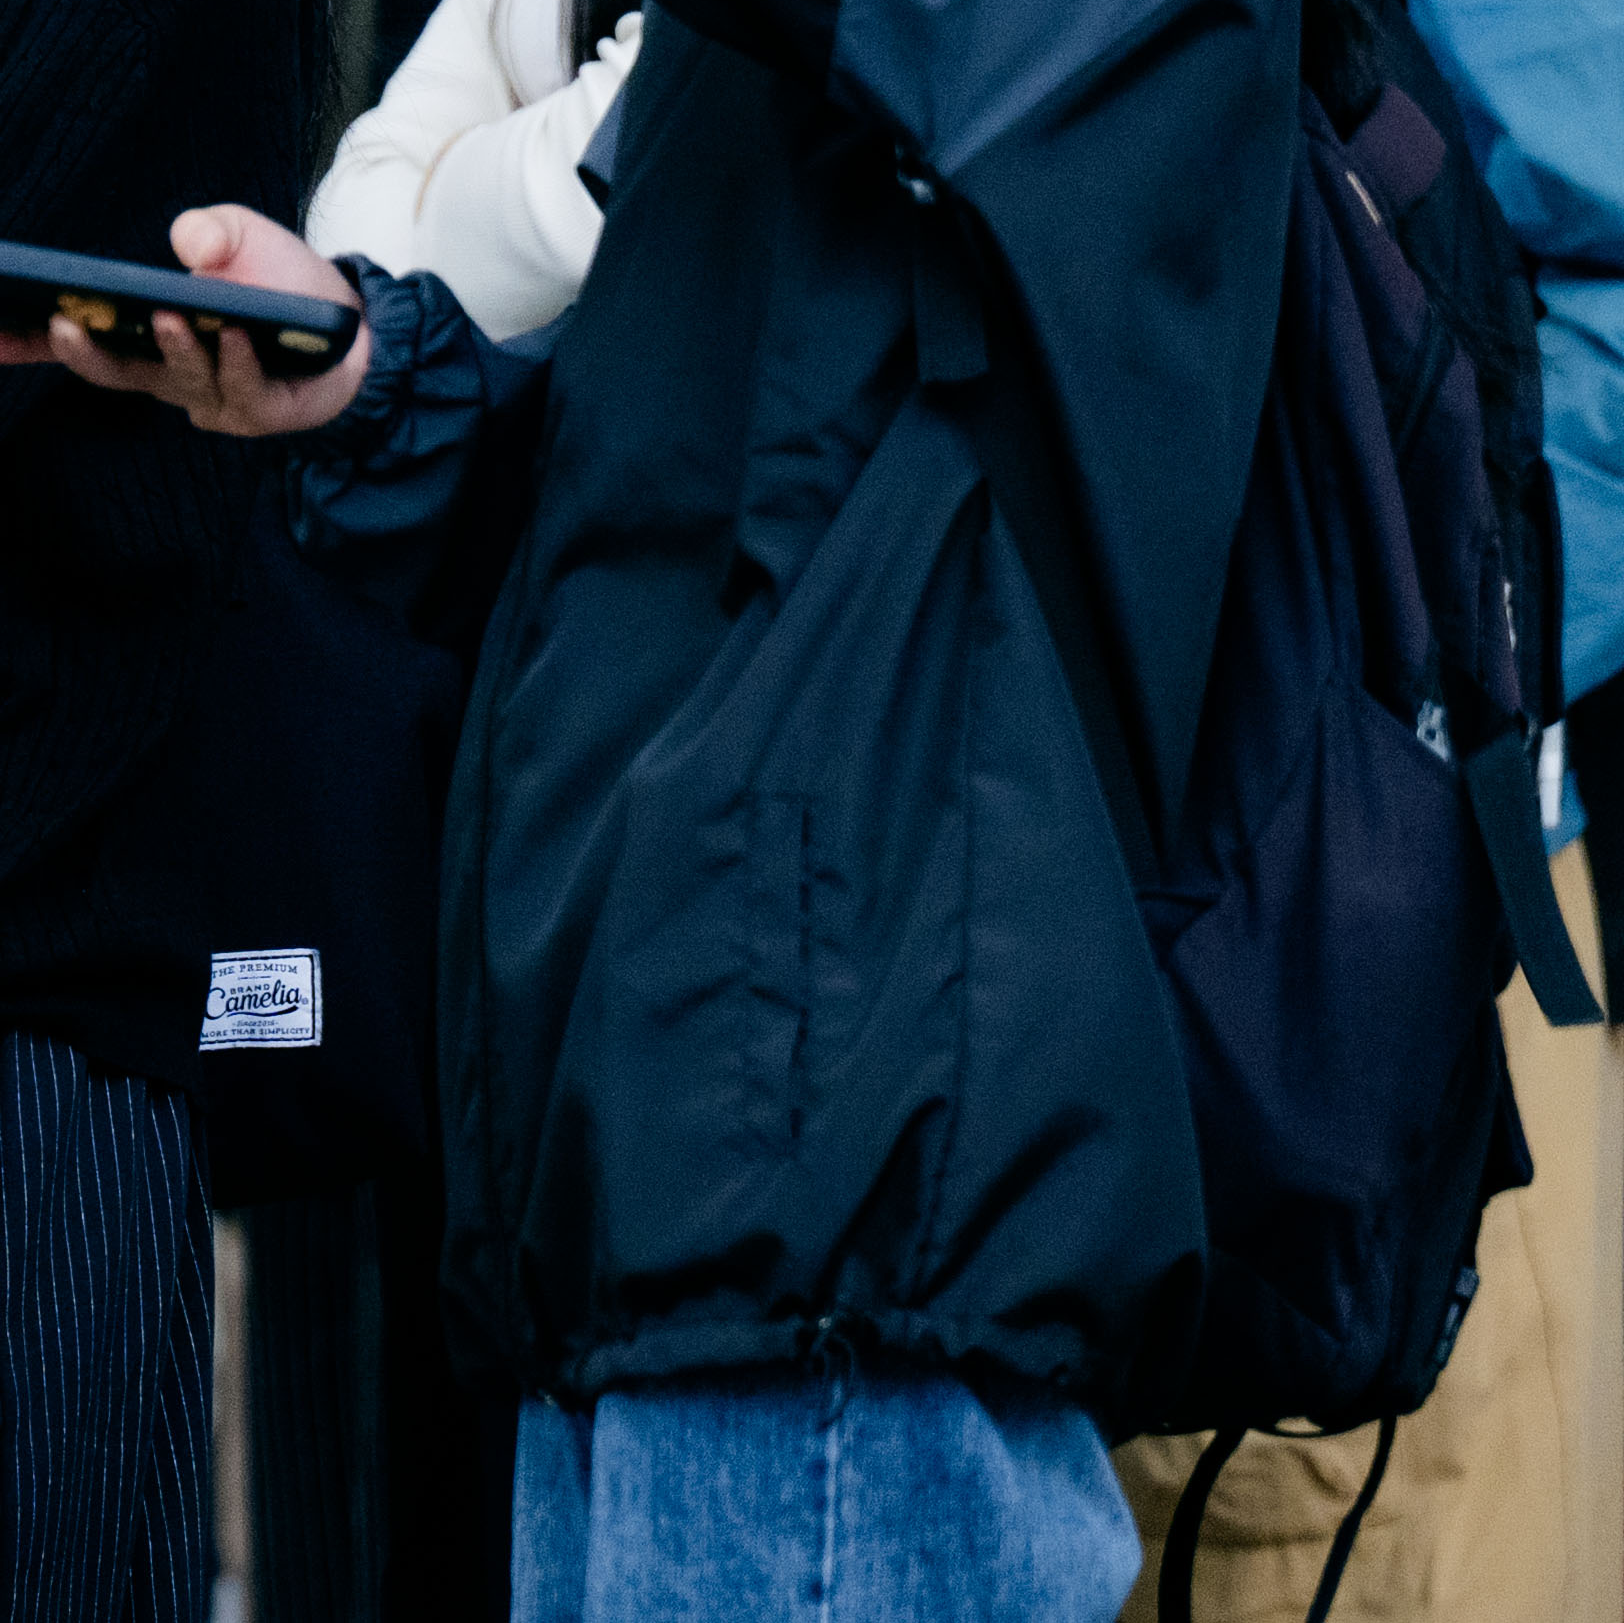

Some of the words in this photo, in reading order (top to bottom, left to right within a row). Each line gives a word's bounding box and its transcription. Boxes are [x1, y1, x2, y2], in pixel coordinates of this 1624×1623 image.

[211, 966, 235, 978] THE
[239, 963, 298, 974] PREMIUM
[230, 983, 270, 995] BRAND
[206, 979, 301, 1020] Camelia
[201, 1030, 228, 1038] MORE
[232, 1027, 256, 1035] THAN
[259, 1027, 310, 1036] SIMPLICITY
